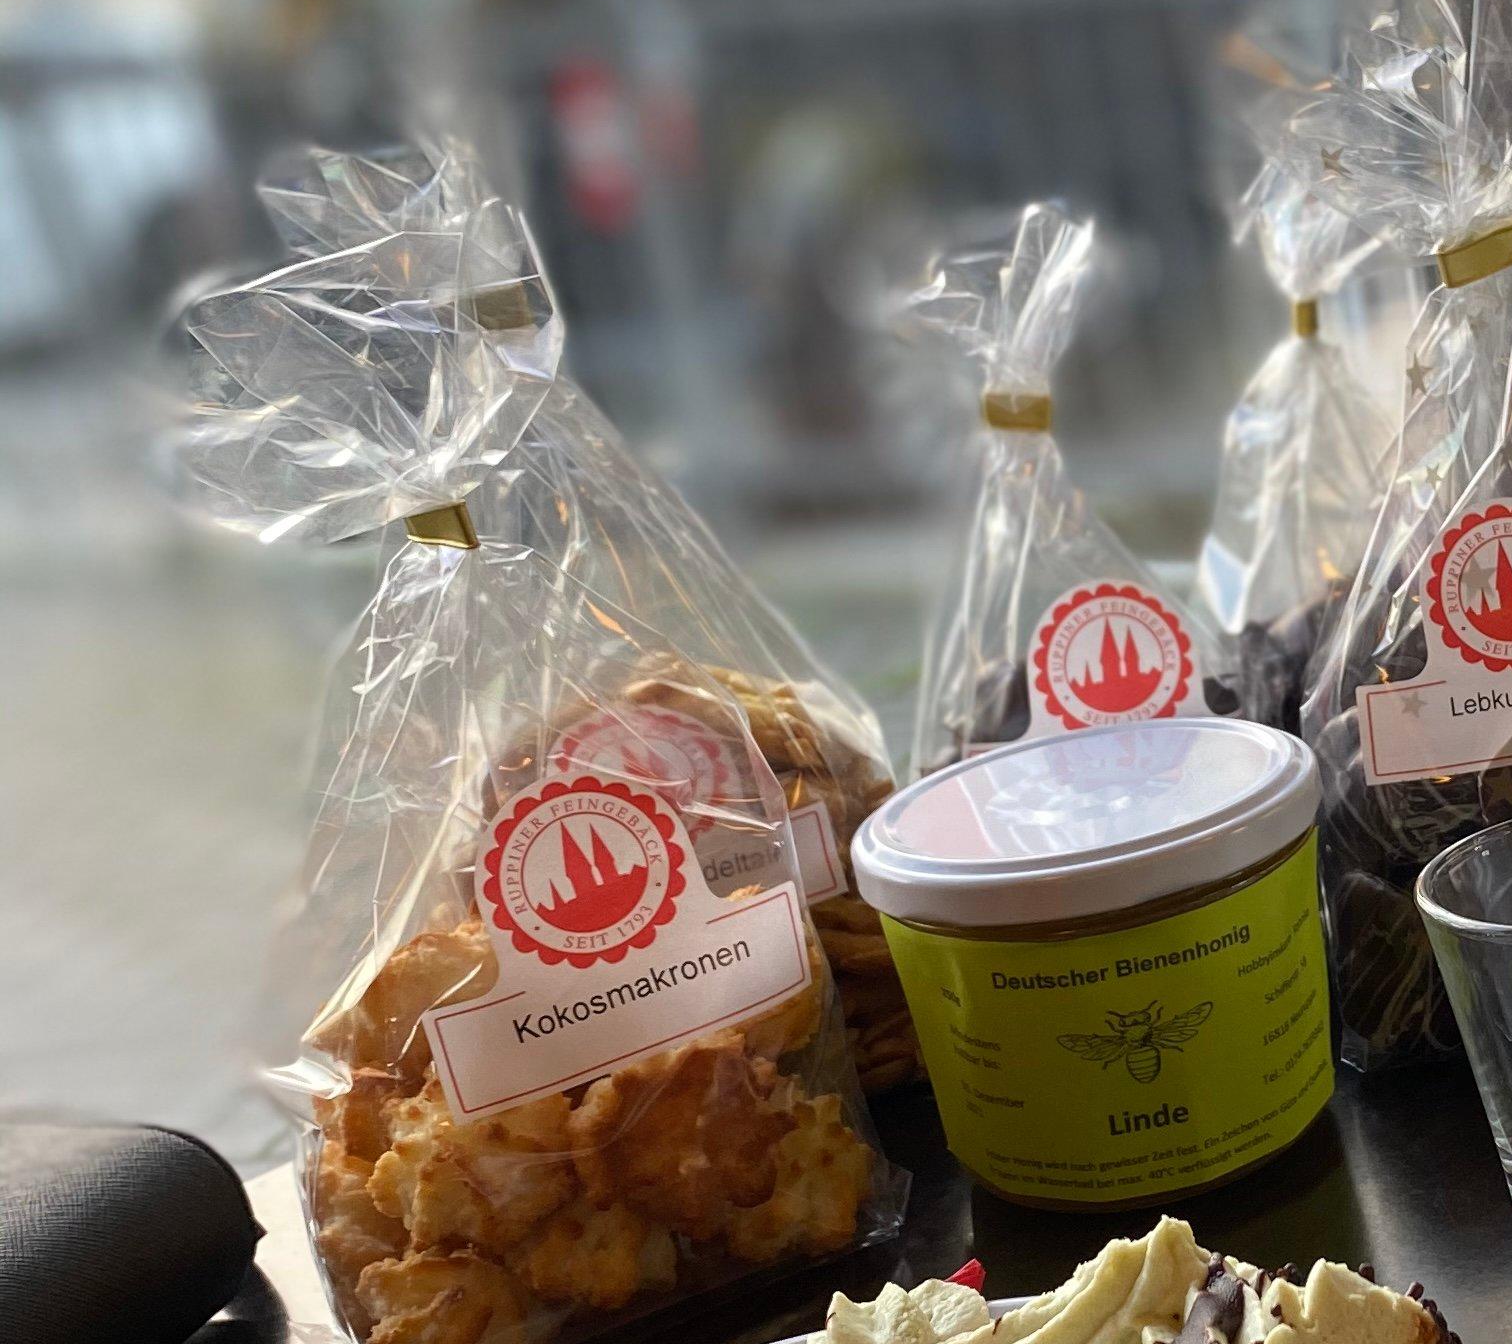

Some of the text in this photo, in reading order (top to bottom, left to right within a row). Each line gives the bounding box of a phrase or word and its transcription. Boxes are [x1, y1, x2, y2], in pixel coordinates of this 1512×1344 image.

[1446, 532, 1484, 614] RUPPINER
[506, 817, 544, 915] RUPPINER
[563, 905, 653, 950] SEIT 1793
[991, 924, 1251, 990] Deutscher Bienenhonig
[512, 938, 751, 1044] Kokosmakronen
[1108, 1103, 1190, 1136] Linde
